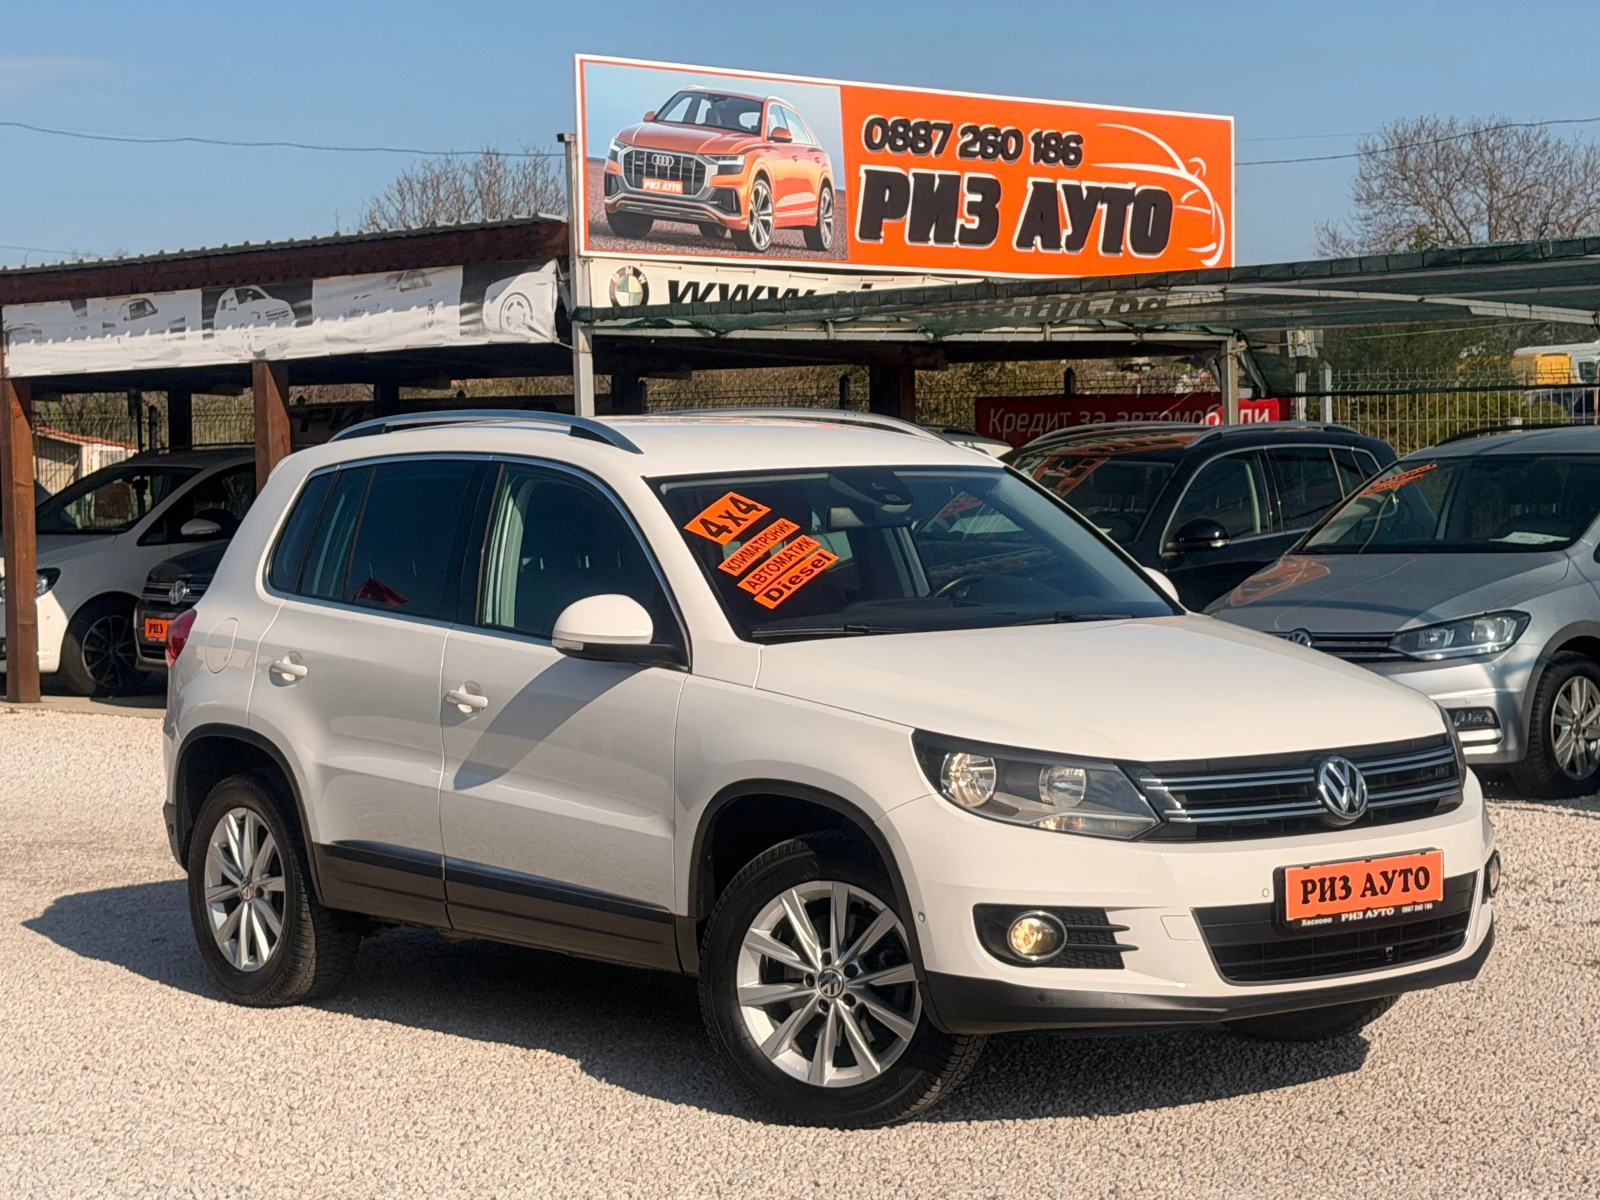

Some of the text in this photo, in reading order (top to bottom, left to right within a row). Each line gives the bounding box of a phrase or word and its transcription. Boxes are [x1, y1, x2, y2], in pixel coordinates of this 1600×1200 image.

[862, 114, 1084, 169] 0887 260 186
[855, 165, 1173, 258] РИЗ АУТО
[989, 407, 1071, 440] Кредит
[724, 521, 795, 572] КЛИМАТРОНИК
[746, 539, 815, 590] АВТОМАТИК
[763, 552, 833, 602] Diesel
[1301, 866, 1430, 905] РИЗ АУТО
[1341, 912, 1363, 922] РИЗ
[1365, 907, 1395, 919] АУТО
